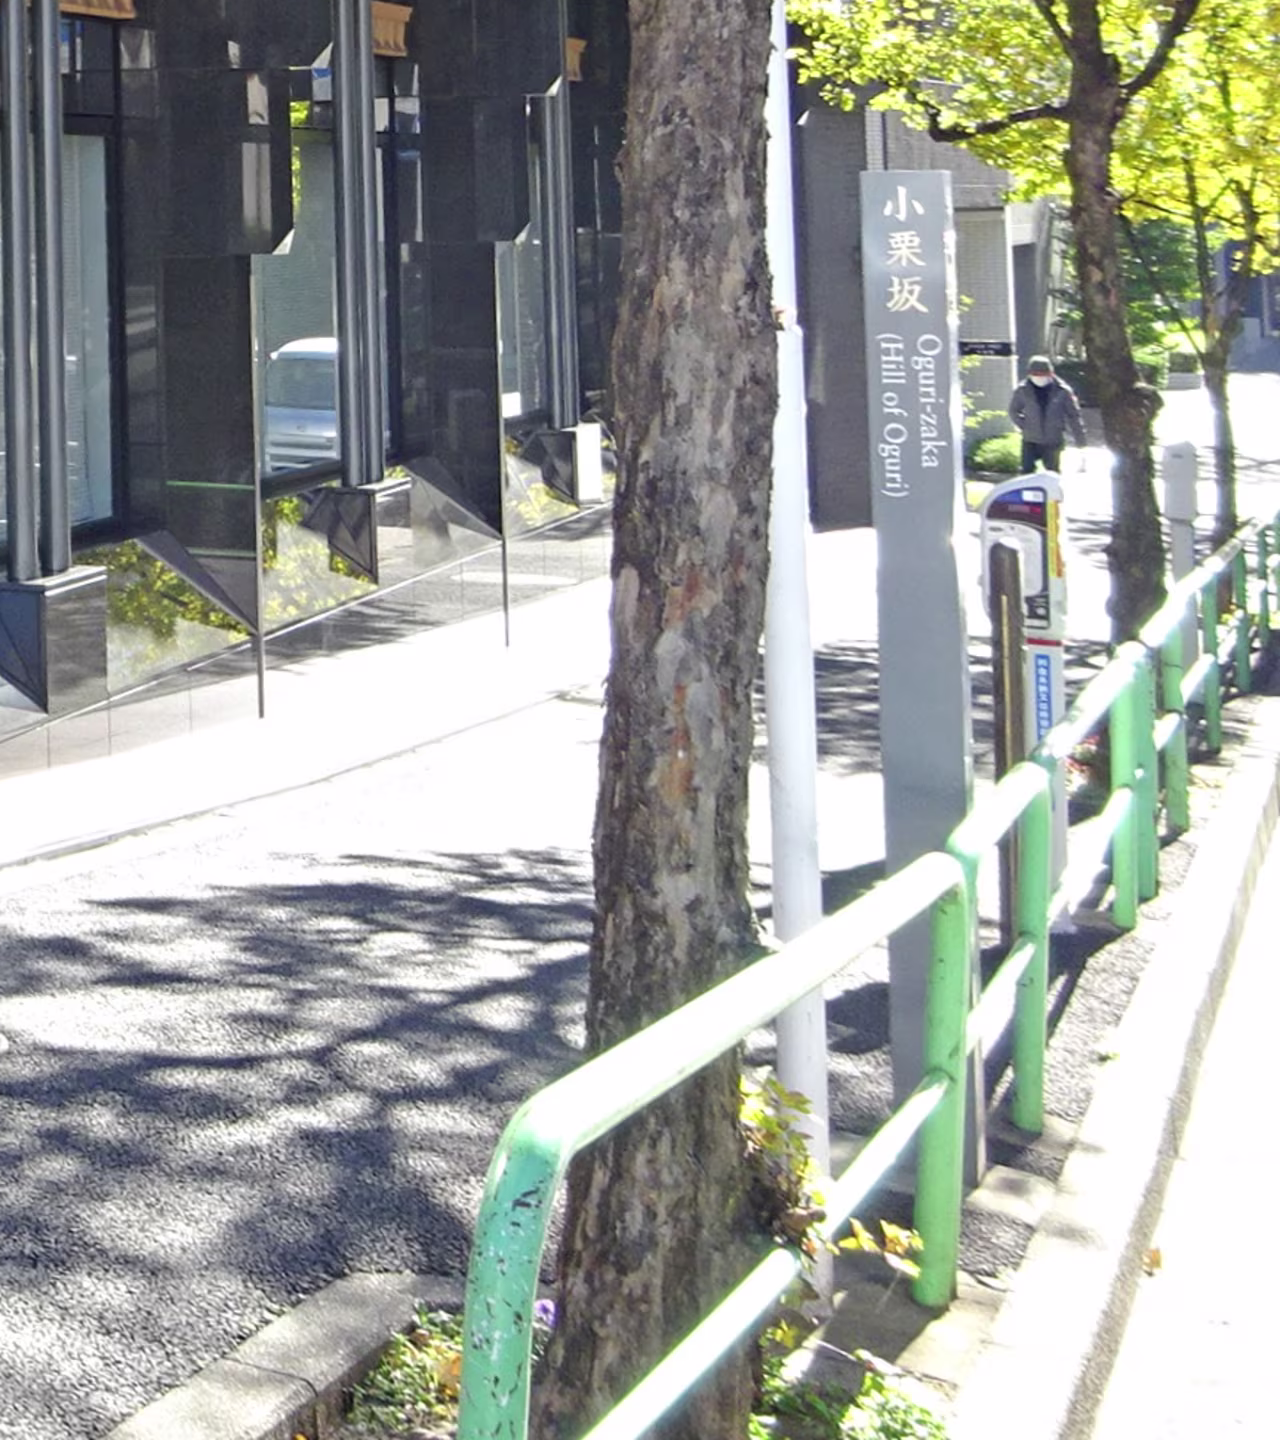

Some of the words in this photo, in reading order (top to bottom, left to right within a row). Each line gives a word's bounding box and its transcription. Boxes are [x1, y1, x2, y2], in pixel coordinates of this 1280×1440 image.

[883, 186, 928, 313] 小栗坂
[876, 333, 906, 384] (Hill
[881, 391, 907, 418] of
[913, 333, 948, 468] Oguri-zaka
[878, 424, 910, 497] Oguri)
